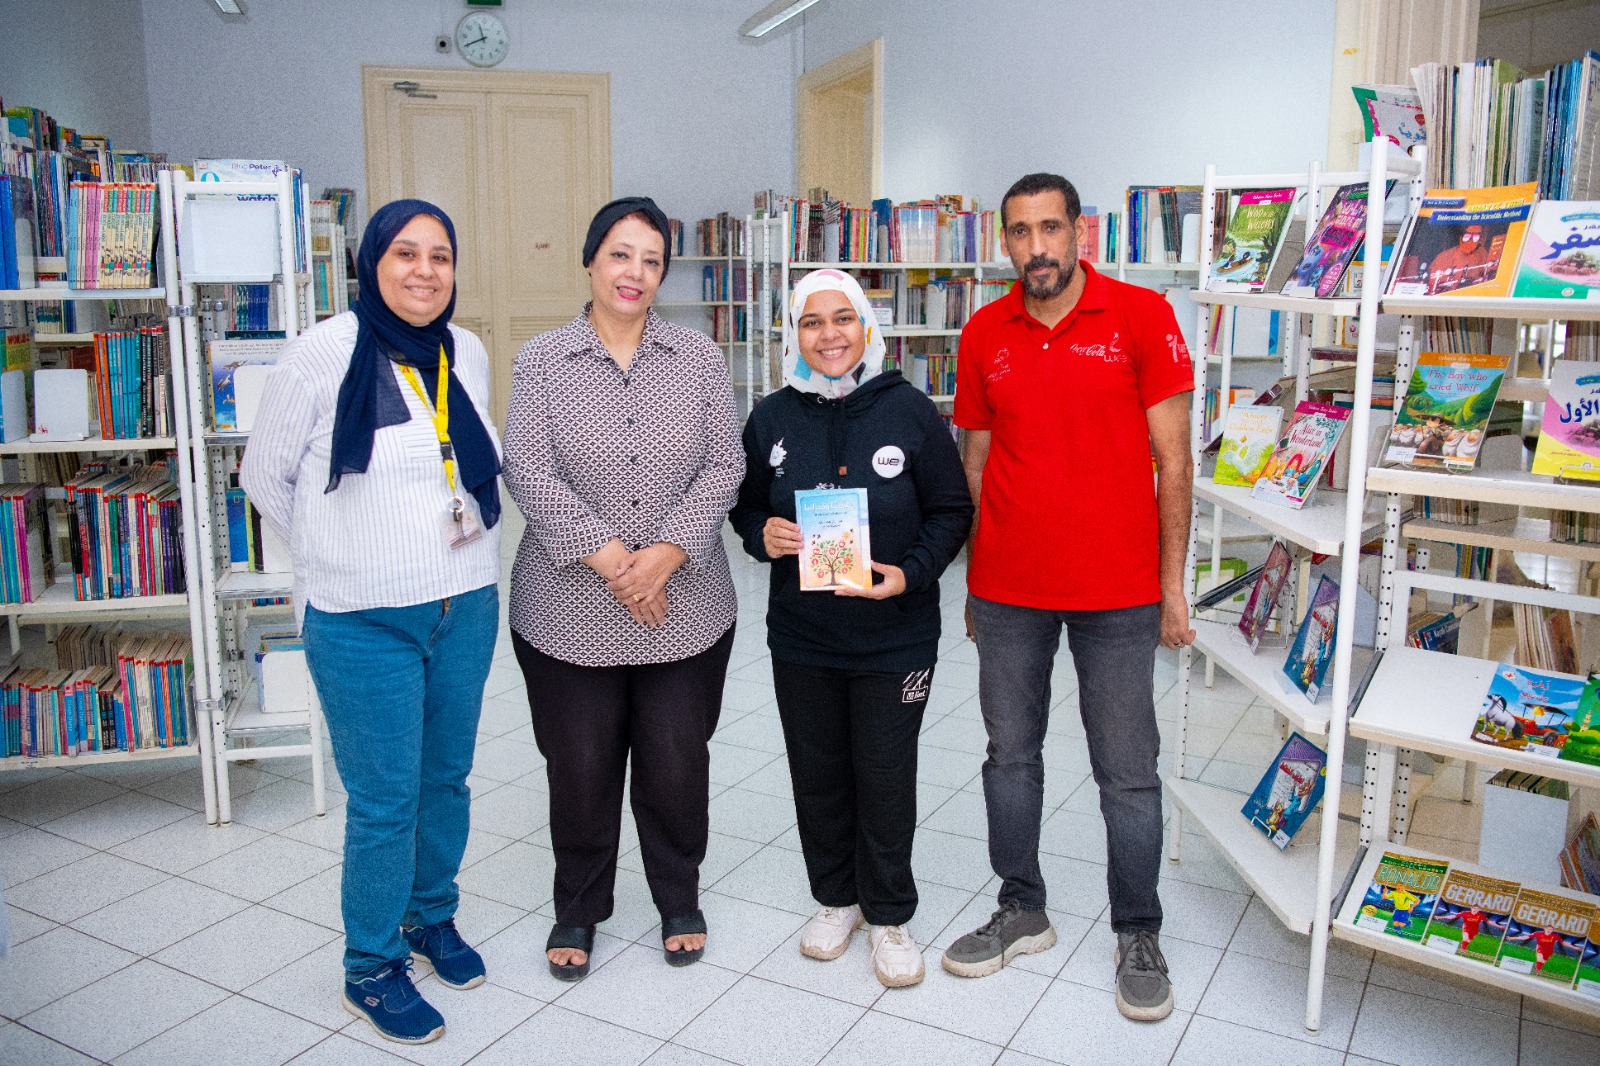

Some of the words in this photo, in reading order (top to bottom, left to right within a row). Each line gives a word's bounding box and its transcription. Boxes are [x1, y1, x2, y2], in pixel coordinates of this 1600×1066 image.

[1437, 213, 1471, 221] Understanding
[1481, 211, 1502, 220] Scientific
[1503, 209, 1522, 218] Method
[1428, 368, 1446, 379] The
[1447, 370, 1466, 380] Boy
[1469, 372, 1488, 381] who
[1429, 381, 1453, 391] cried
[1456, 383, 1480, 392] Wolf
[1559, 397, 1600, 424] الأول
[1377, 865, 1441, 891] RONALDO
[1445, 883, 1514, 913] GERRARD
[1517, 903, 1589, 935] GERRARD
